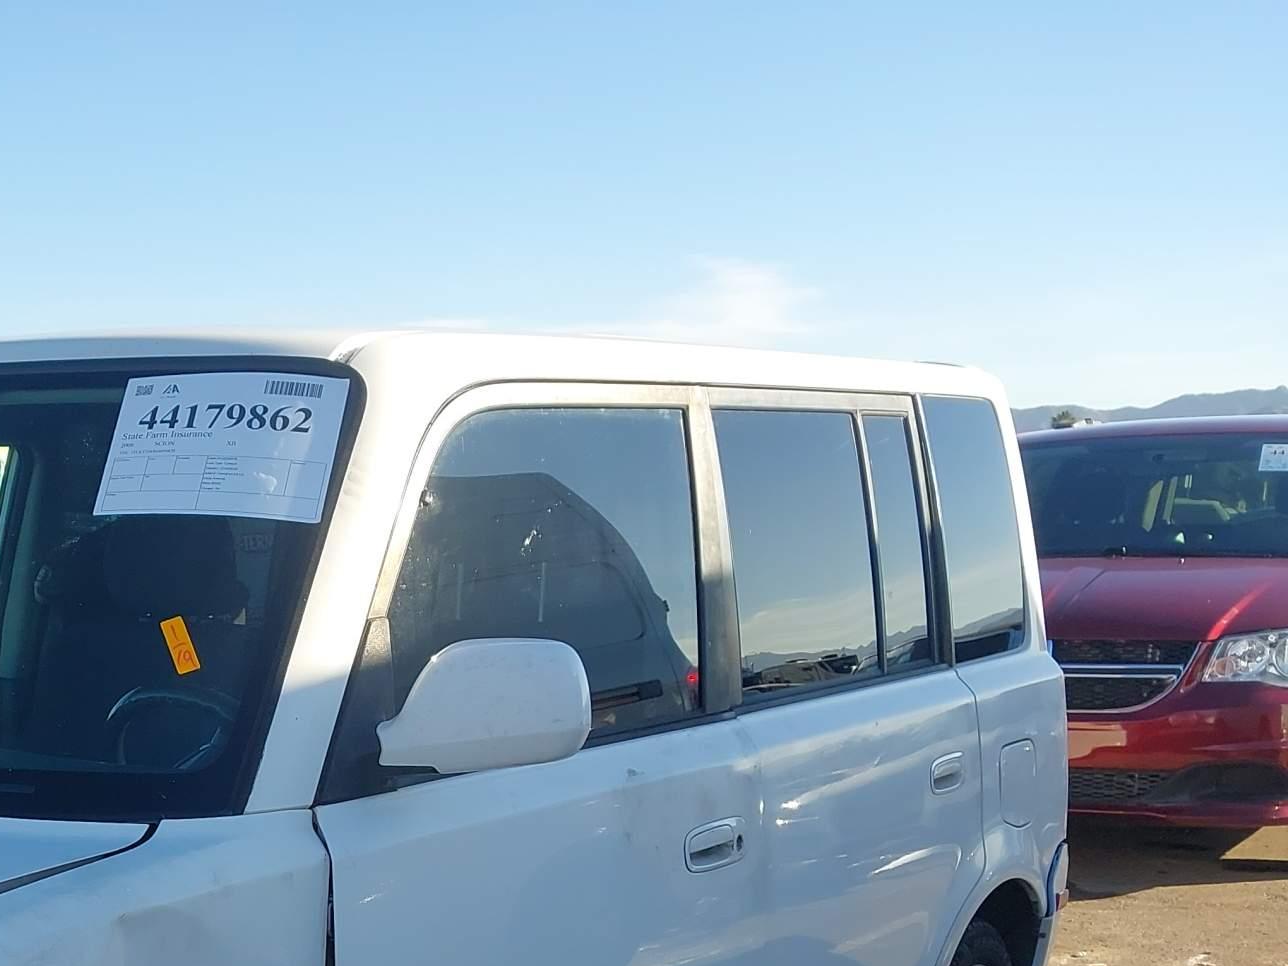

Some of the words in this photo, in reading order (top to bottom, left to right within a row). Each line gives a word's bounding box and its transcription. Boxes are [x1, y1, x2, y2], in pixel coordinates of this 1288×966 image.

[138, 403, 313, 434] 44179862
[122, 432, 143, 440] State
[145, 431, 168, 440] Farm
[171, 430, 213, 439] Insurance
